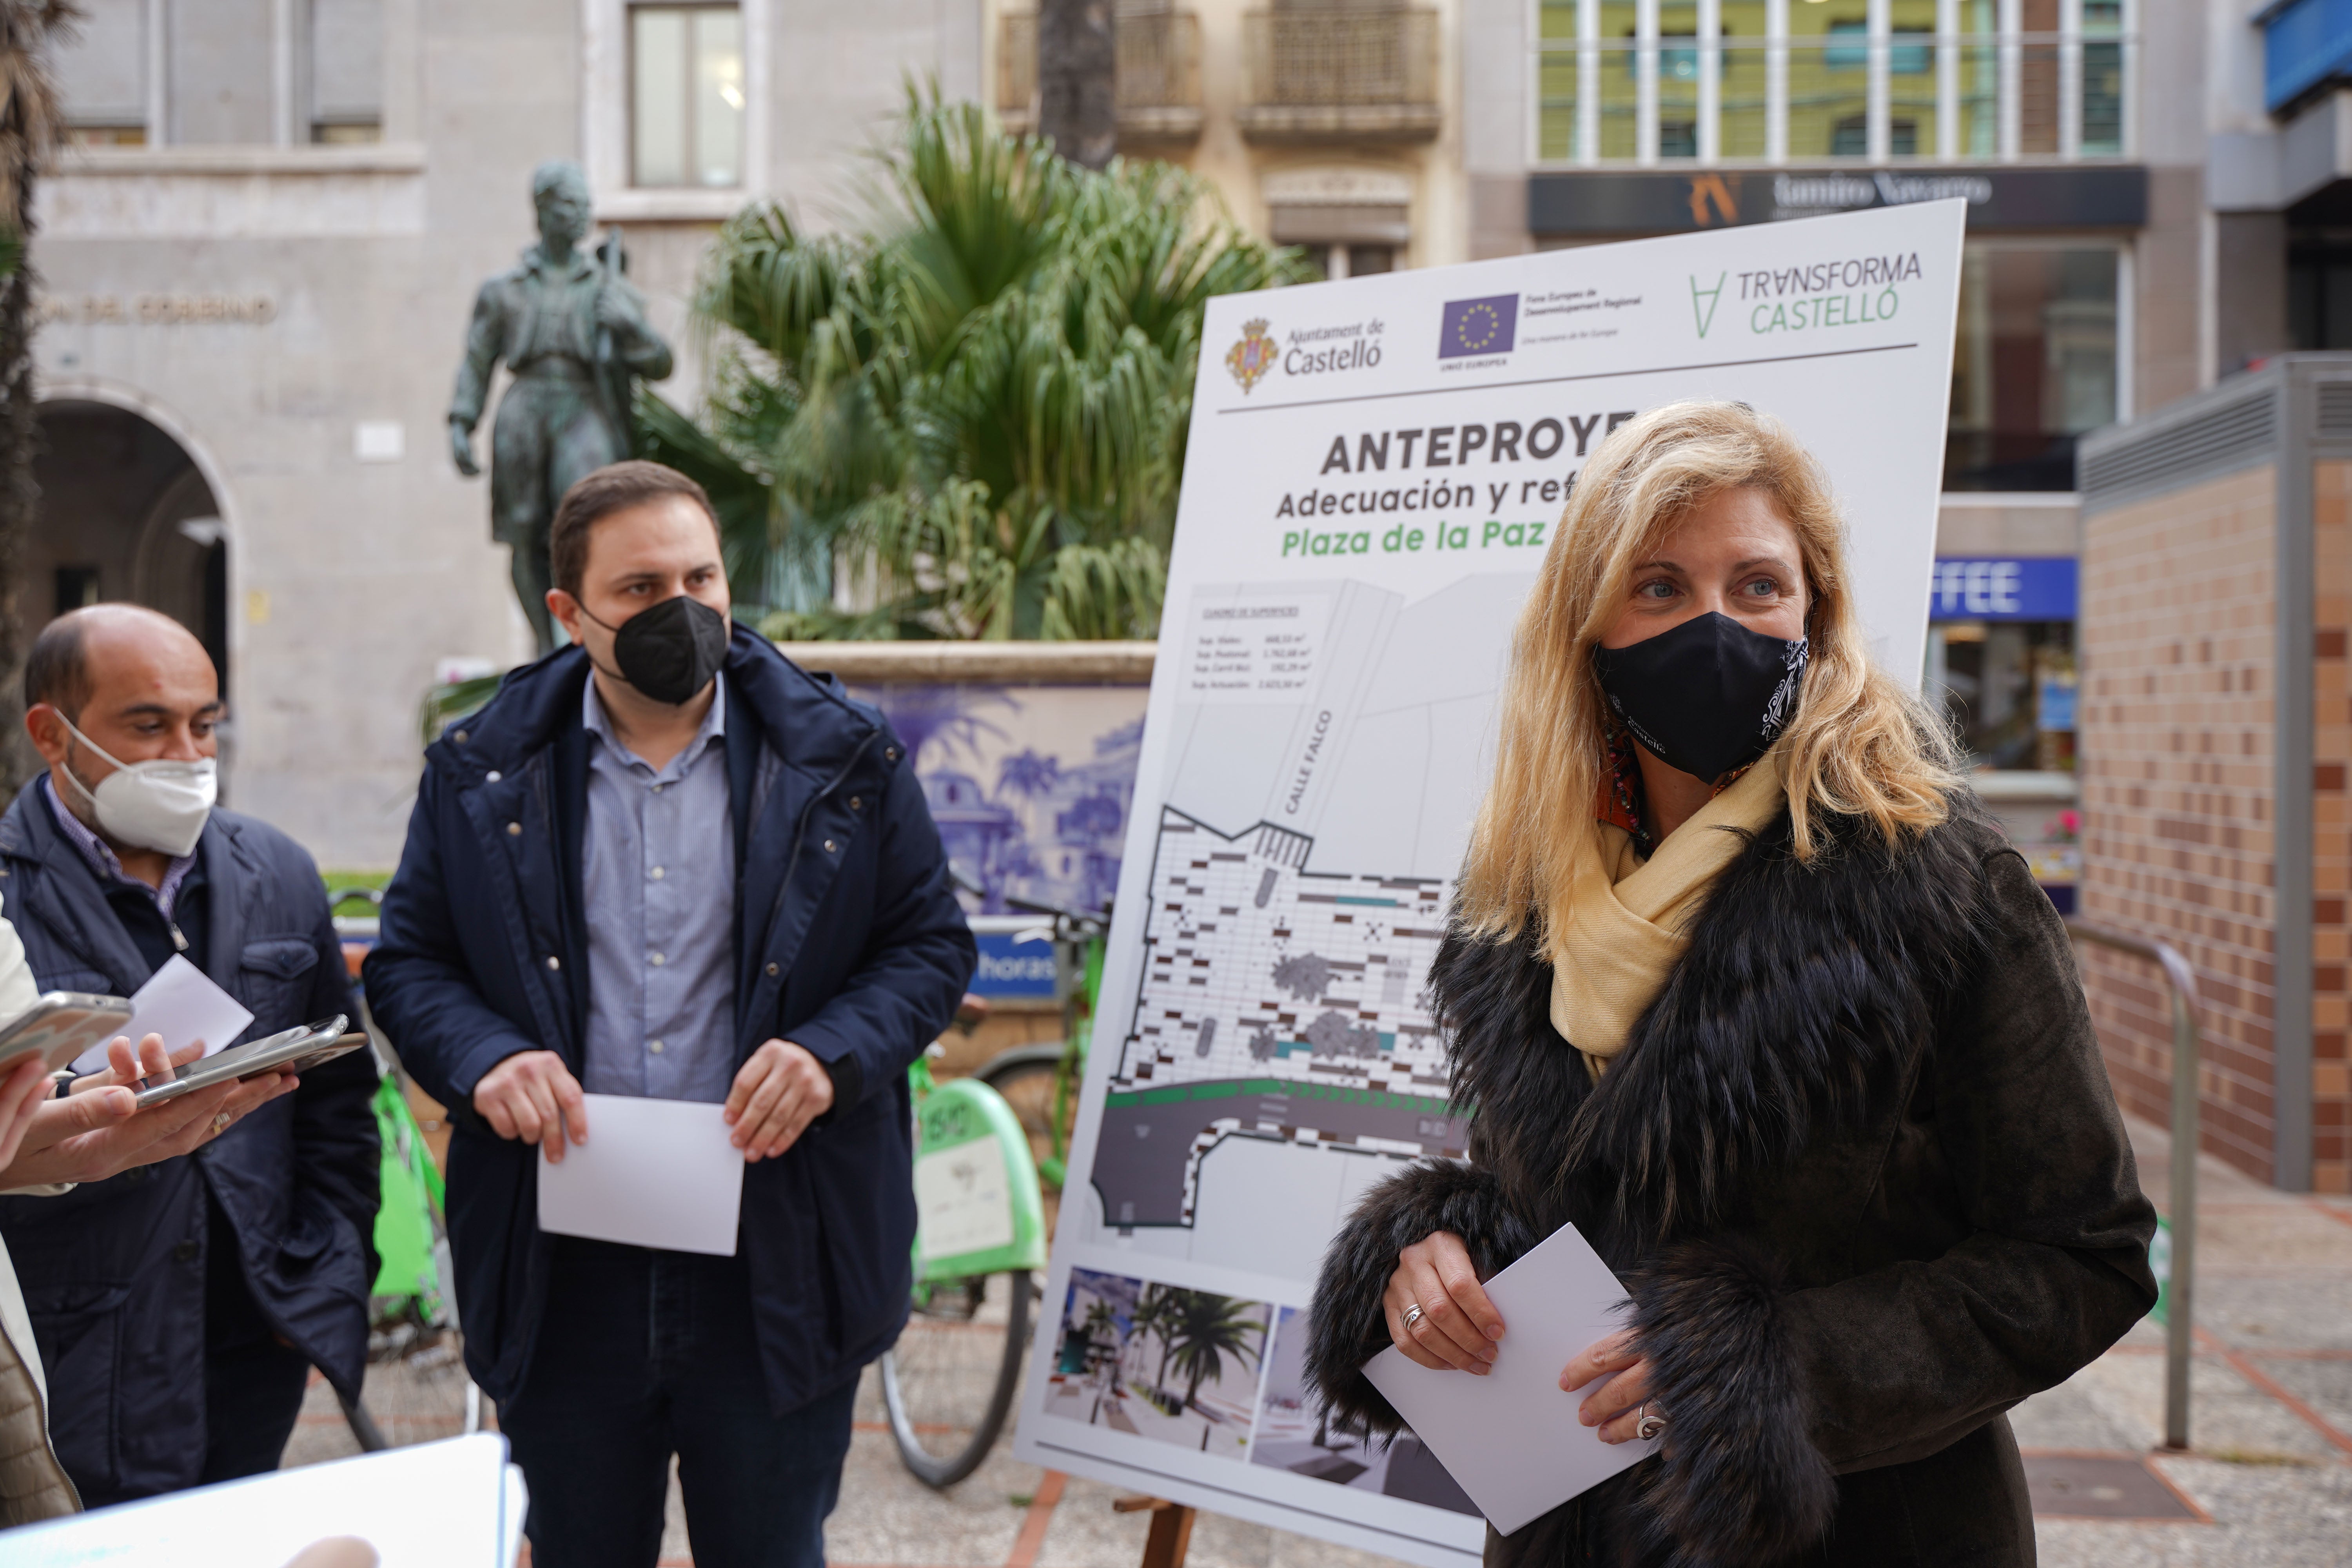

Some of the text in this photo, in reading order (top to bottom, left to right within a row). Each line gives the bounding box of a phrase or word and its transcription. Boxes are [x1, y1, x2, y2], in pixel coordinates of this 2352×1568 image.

[1738, 251, 1922, 300] TRANSFORMA
[1751, 282, 1899, 334] CASTELLÓ
[1287, 318, 1385, 346] Ajuntament de
[1284, 338, 1381, 376] Castelló
[1276, 479, 1475, 519] Adecuación
[1489, 481, 1510, 515] y
[1281, 521, 1546, 557] Plaza de la Paz
[1285, 710, 1332, 815] CALLE FALCO
[978, 950, 1057, 981] horas
